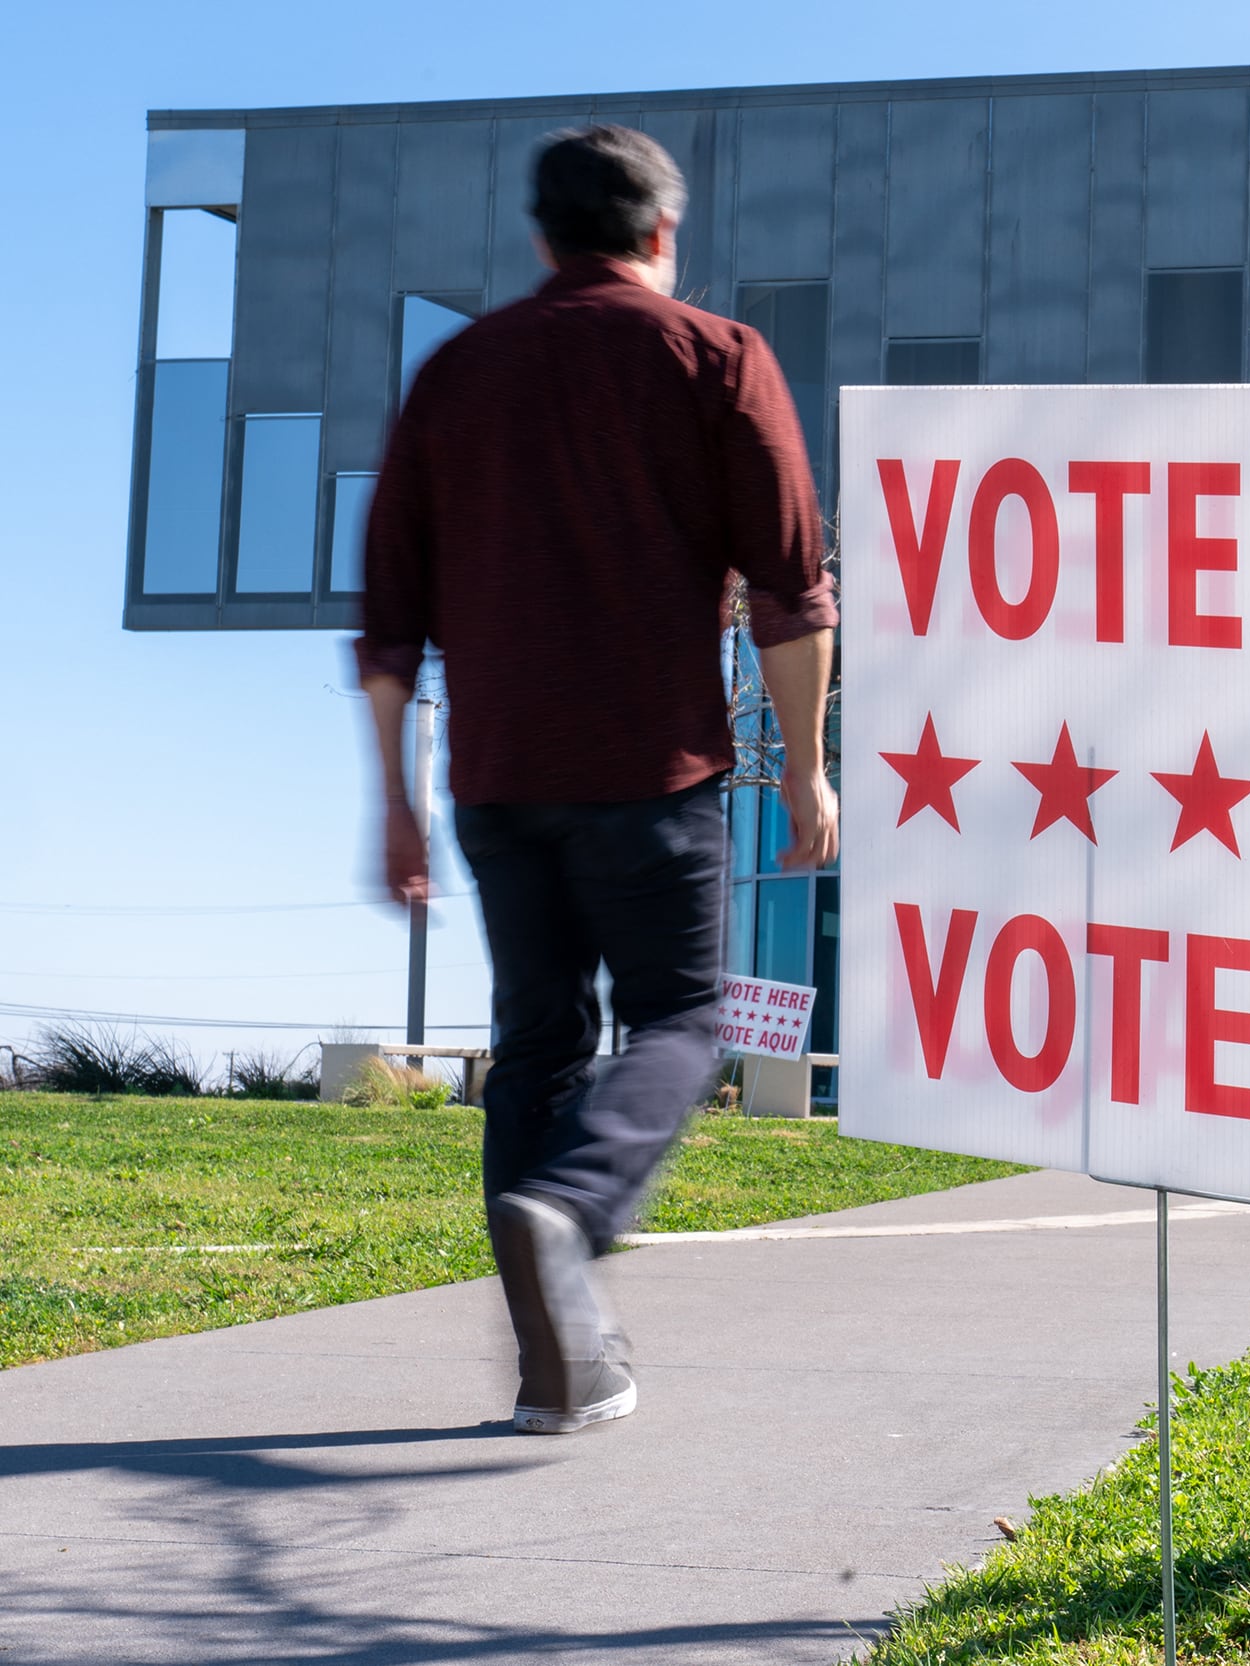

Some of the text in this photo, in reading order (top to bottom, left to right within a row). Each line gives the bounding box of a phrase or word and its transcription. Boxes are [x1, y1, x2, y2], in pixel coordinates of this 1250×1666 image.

[877, 458, 1242, 649] VOTE
[722, 980, 811, 1011] VOTE HERE
[714, 1022, 799, 1053] VOTE AQUI
